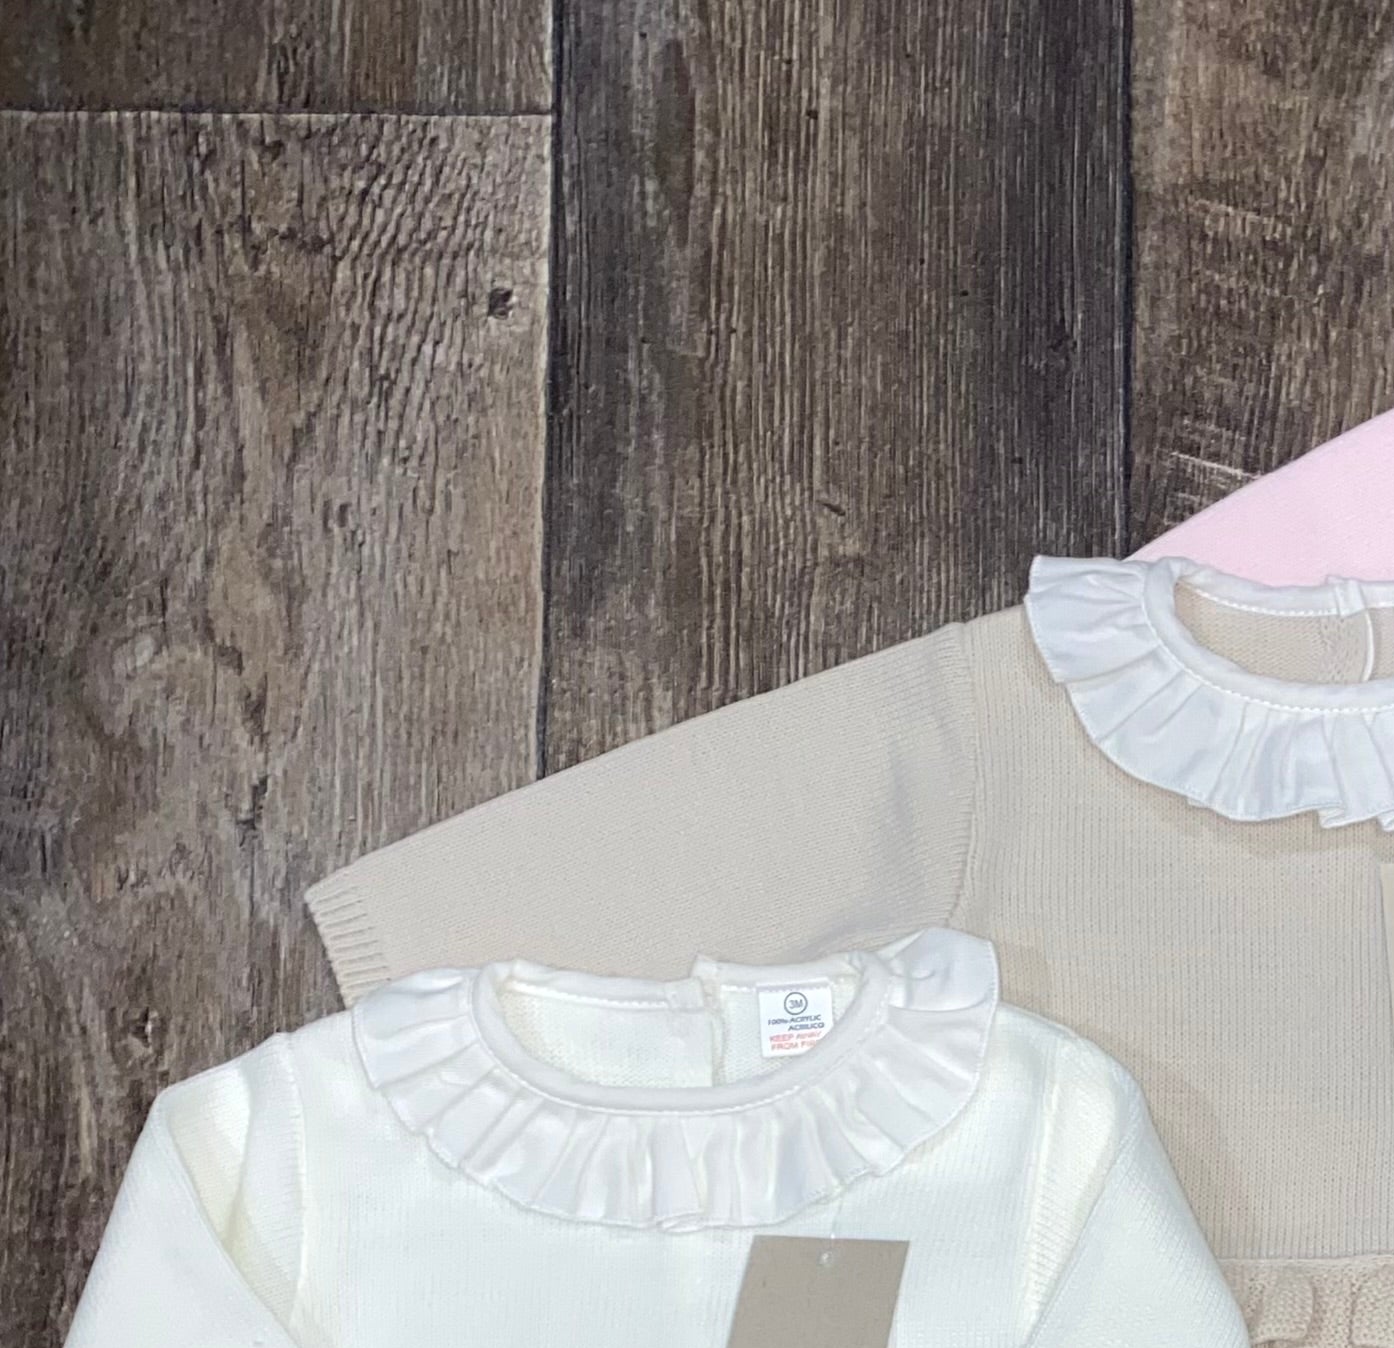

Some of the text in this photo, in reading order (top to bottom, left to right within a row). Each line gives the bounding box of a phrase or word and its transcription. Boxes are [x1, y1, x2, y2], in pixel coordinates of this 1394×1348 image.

[788, 999, 804, 1009] 3M
[769, 1033, 794, 1042] KEEP
[771, 1042, 799, 1051] FROM
